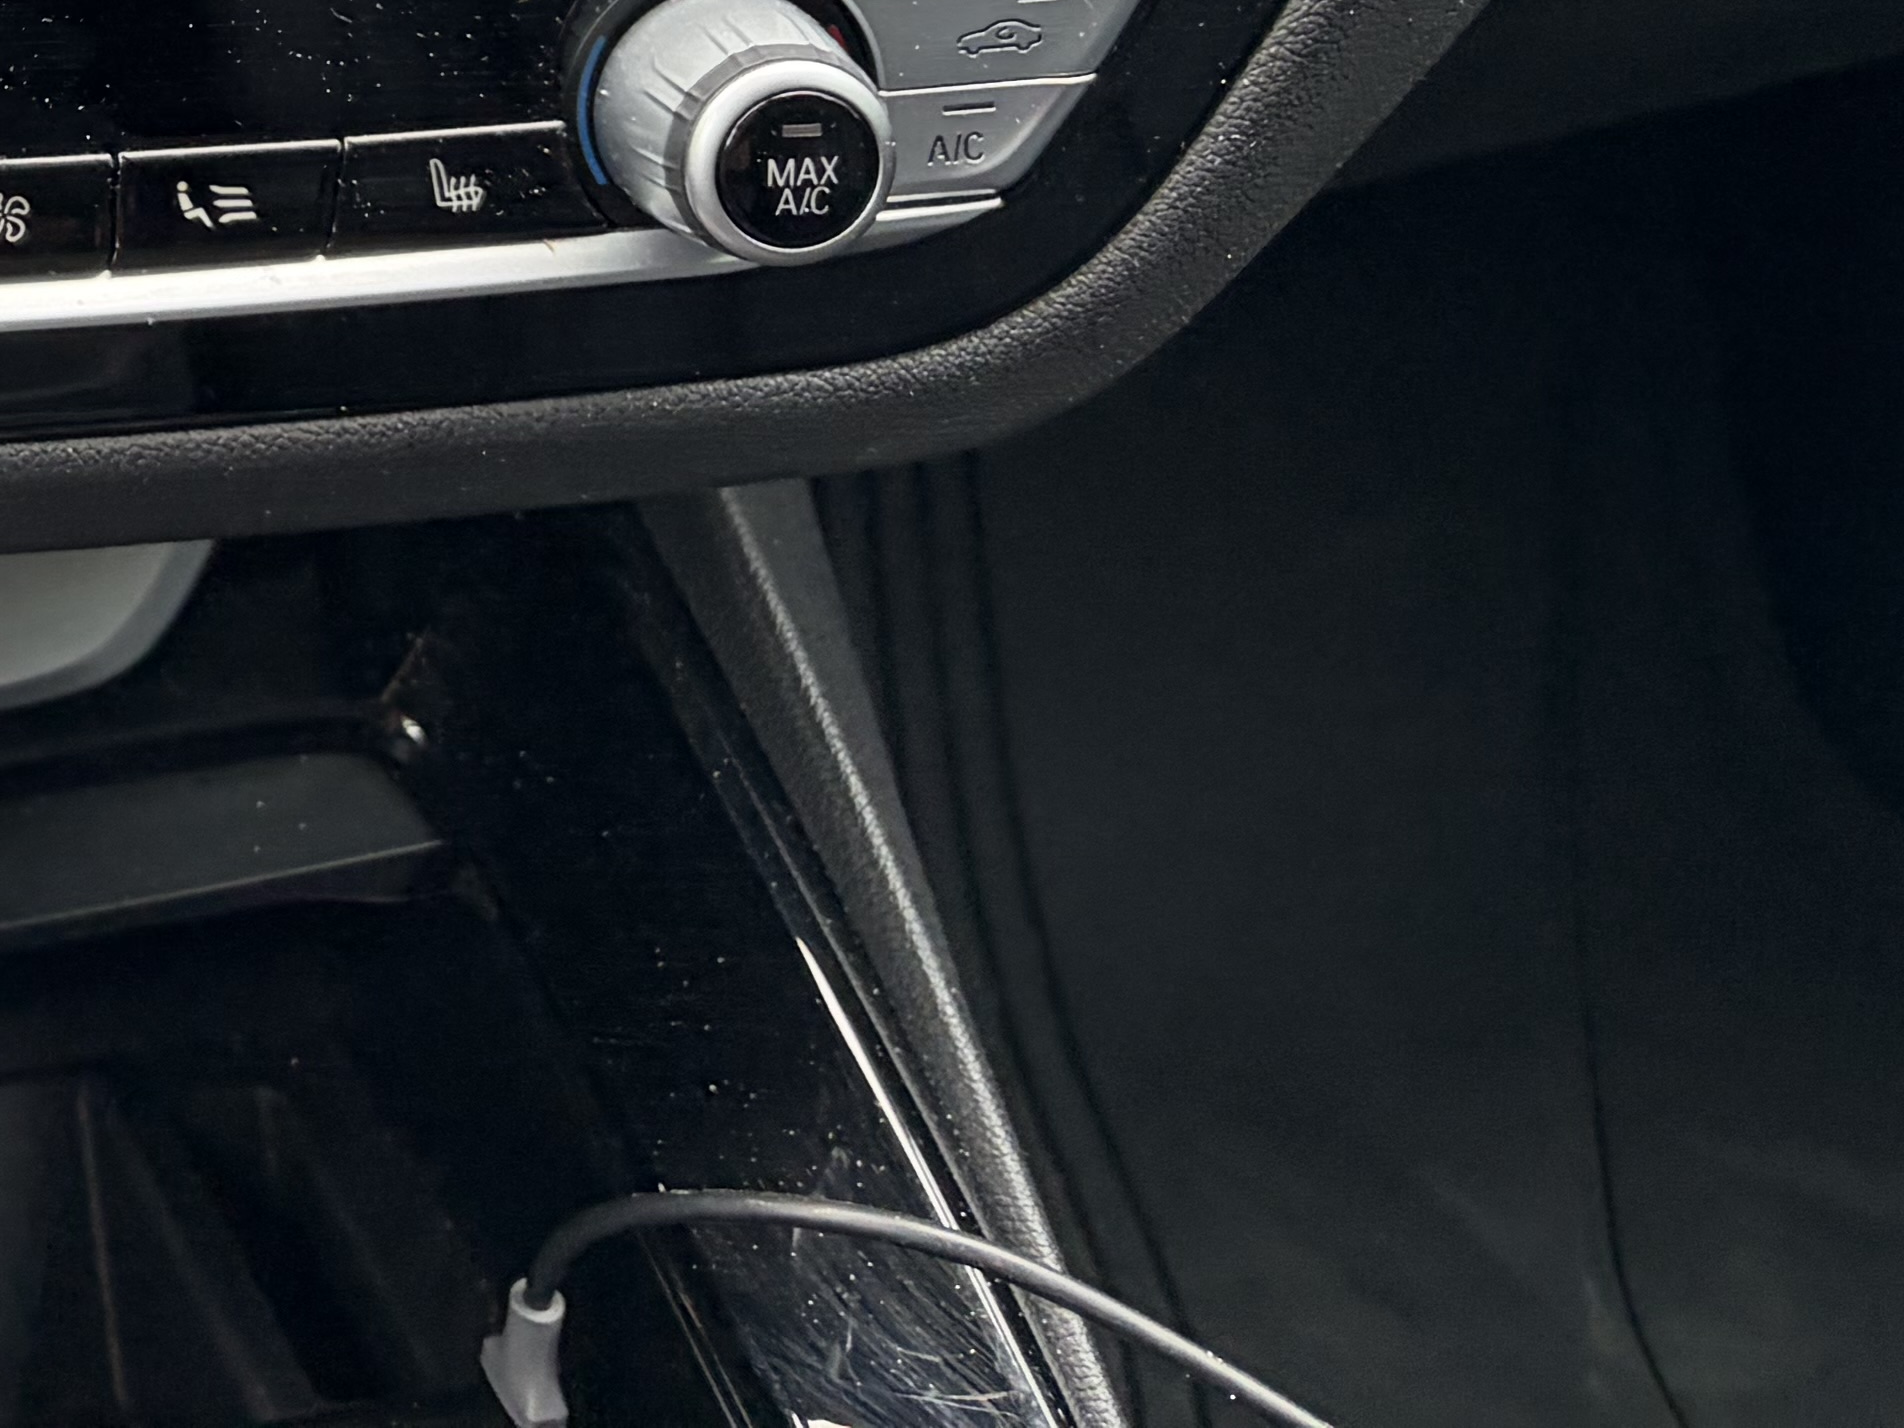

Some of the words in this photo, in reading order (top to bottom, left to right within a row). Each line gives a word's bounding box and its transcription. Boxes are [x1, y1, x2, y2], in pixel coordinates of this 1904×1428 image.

[926, 132, 985, 166] A/C
[768, 156, 839, 188] MAX
[775, 186, 830, 215] A/C
